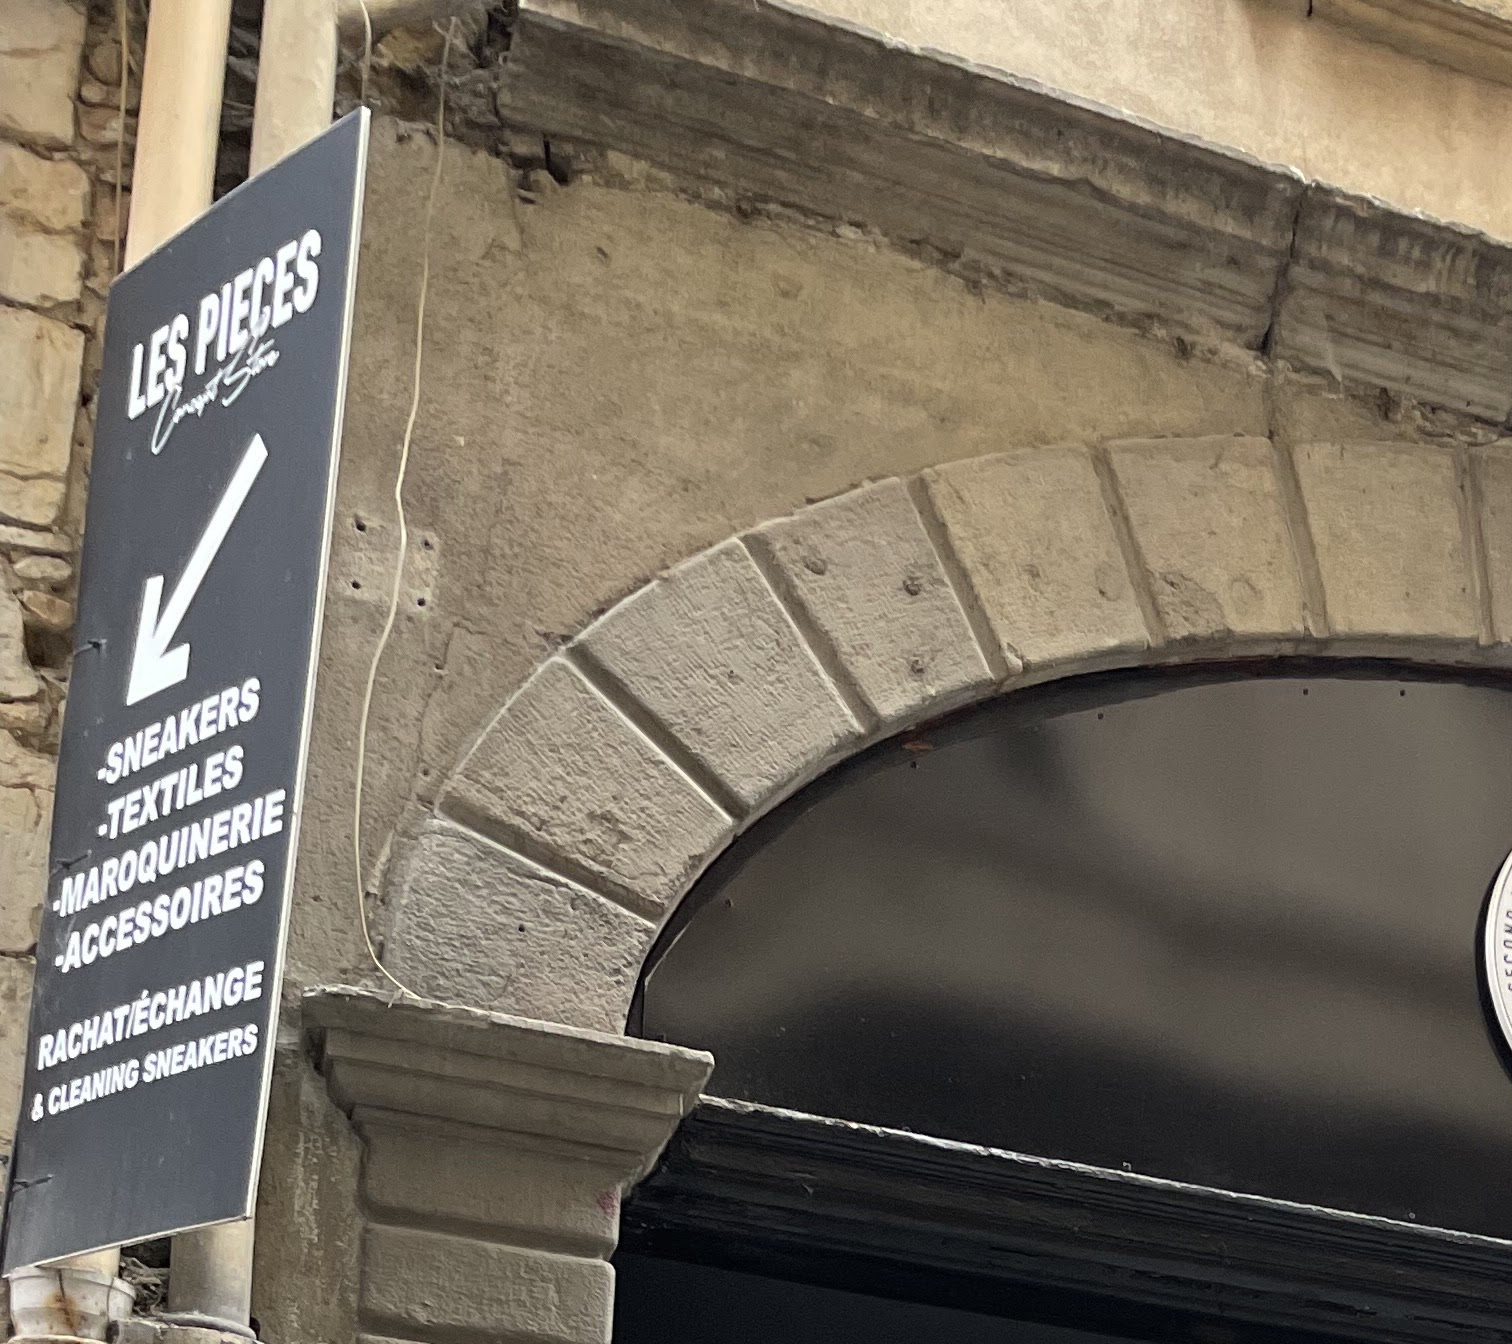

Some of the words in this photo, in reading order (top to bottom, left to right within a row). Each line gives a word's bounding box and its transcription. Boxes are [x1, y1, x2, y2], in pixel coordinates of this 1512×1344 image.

[128, 313, 190, 420] LES
[195, 230, 322, 376] PIECES
[30, 1094, 44, 1123] &
[48, 1059, 140, 1117] CLEANING
[142, 1023, 260, 1083] SNEAKERS
